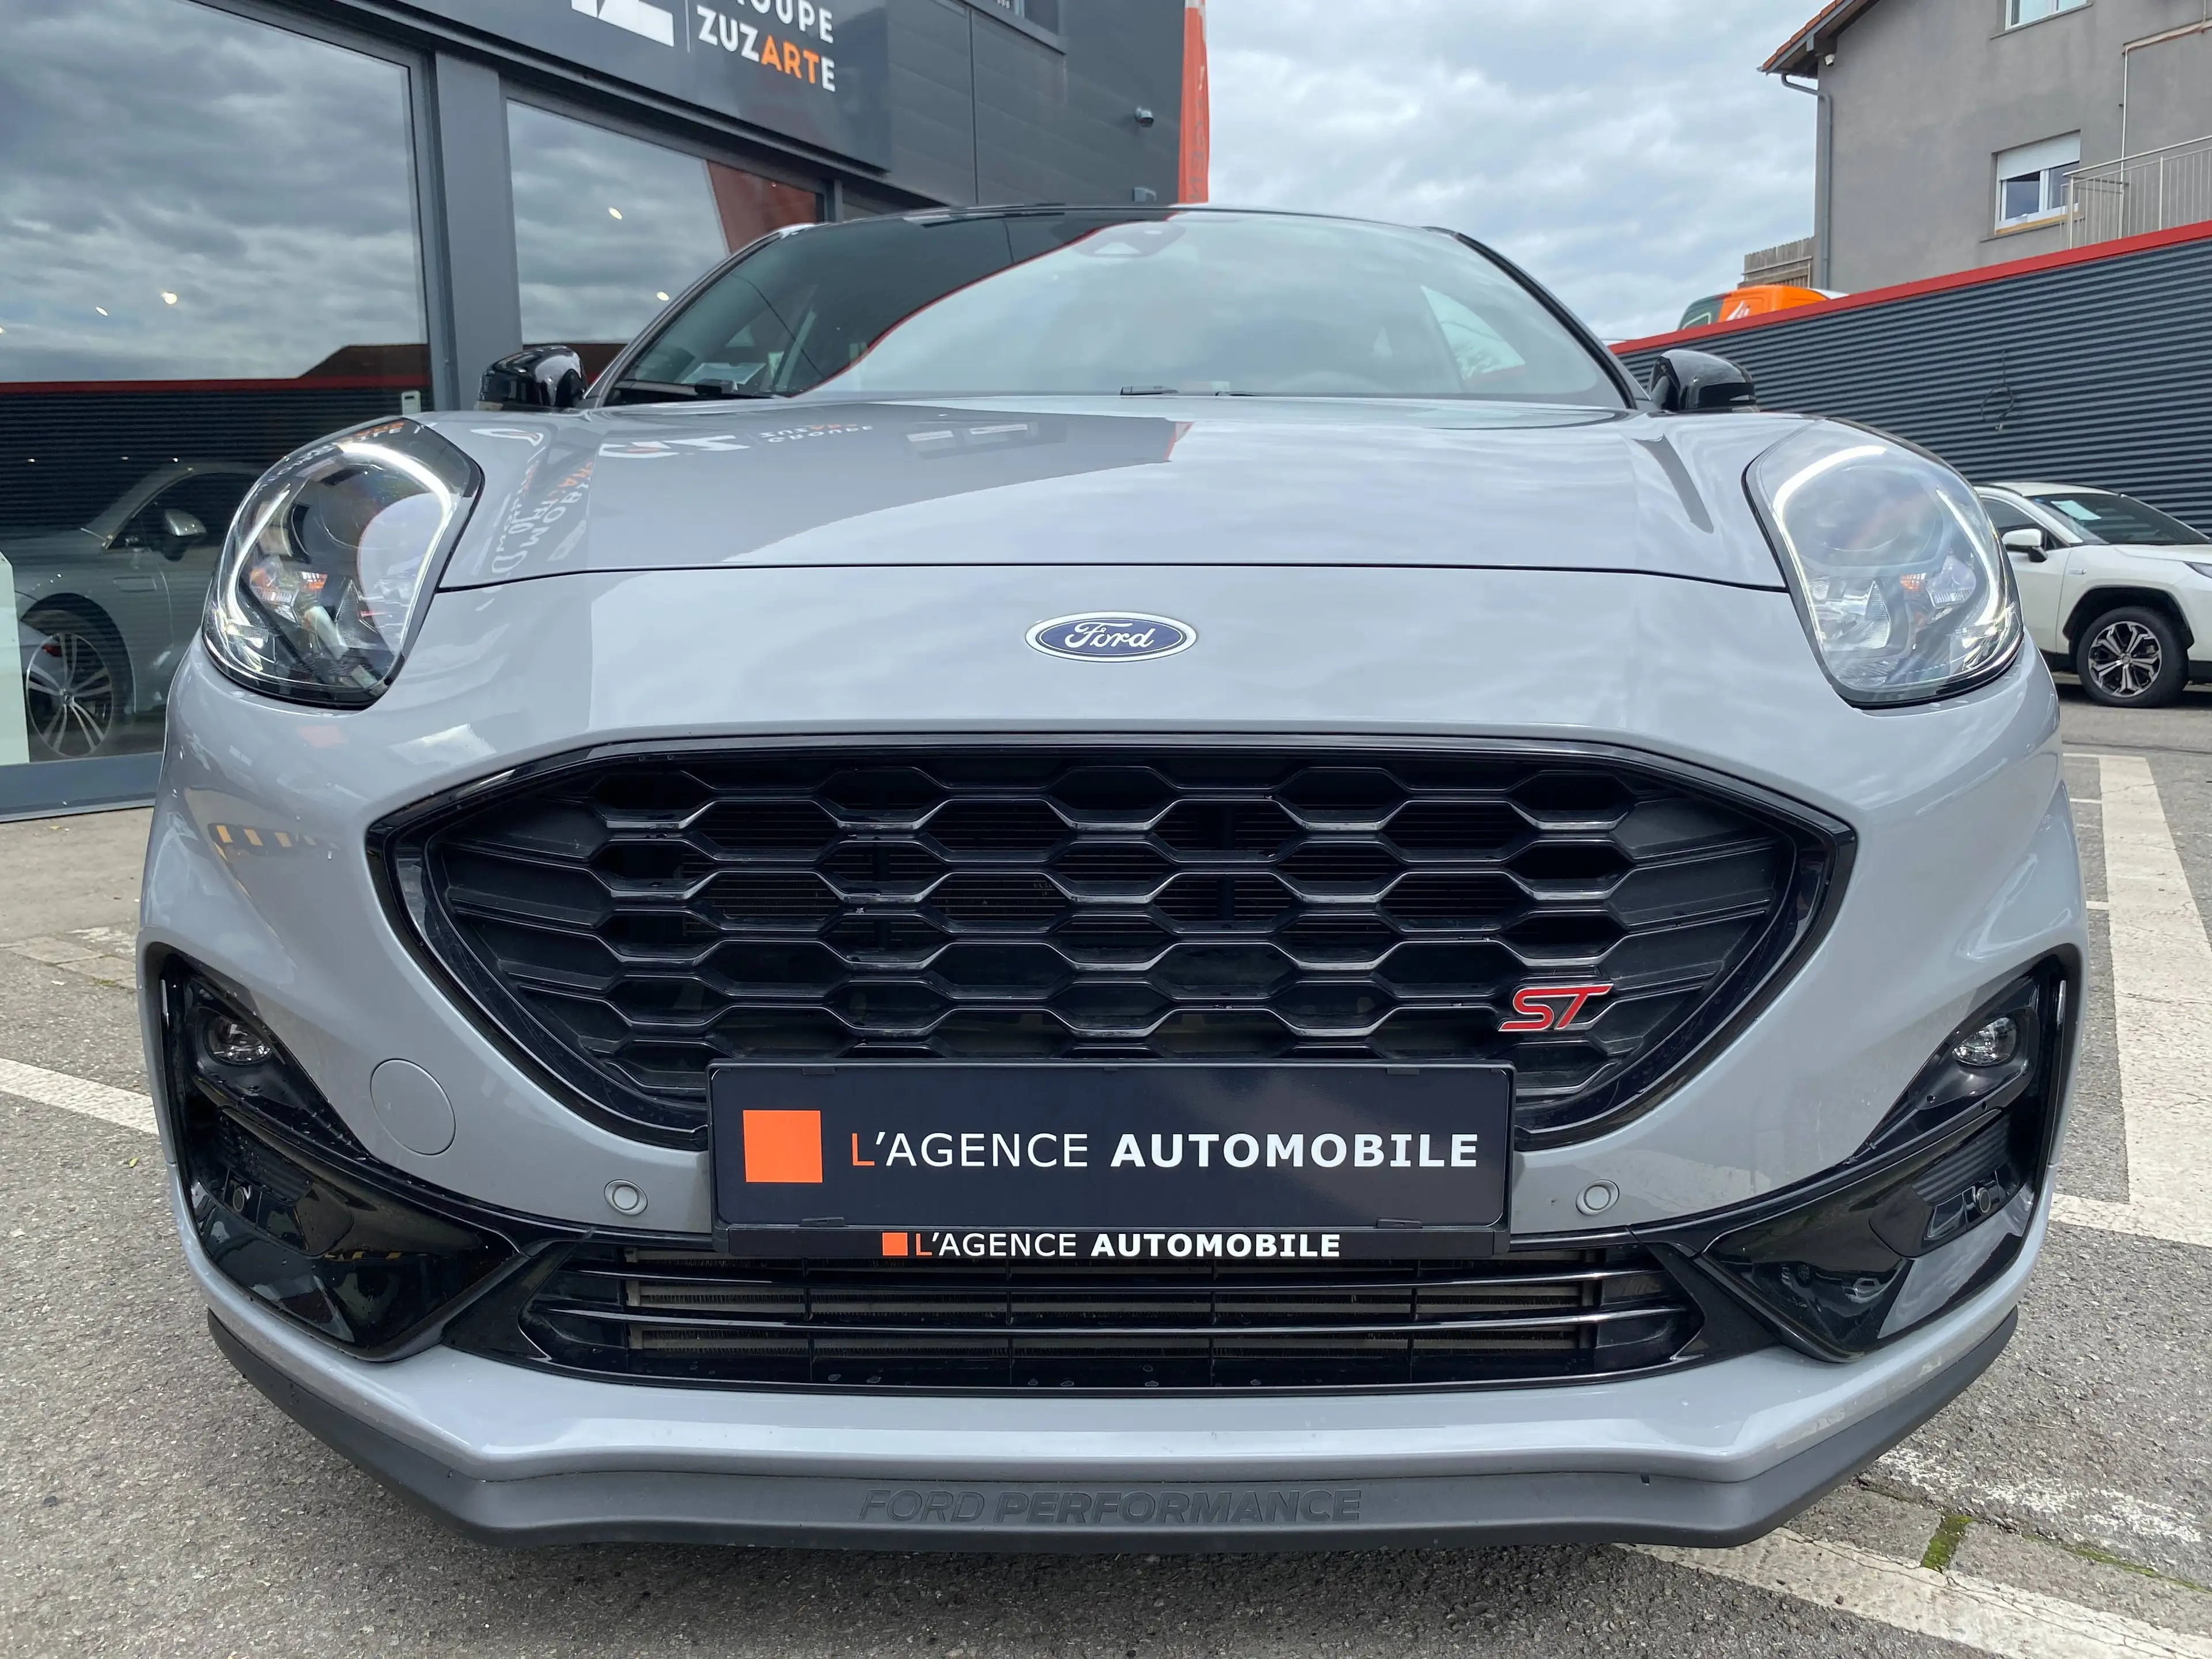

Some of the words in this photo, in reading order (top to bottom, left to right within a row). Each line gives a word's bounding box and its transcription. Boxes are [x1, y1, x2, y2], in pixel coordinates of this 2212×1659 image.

[696, 5, 836, 92] ZUZARTE
[1065, 621, 1157, 649] Ford
[1498, 983, 1614, 1032] ST
[1109, 1132, 1478, 1168] AUTOMOBILE
[1090, 1233, 1340, 1257] AUTOMOBILE
[857, 1488, 985, 1522] FORD
[992, 1489, 1362, 1524] PERFORMANCE
